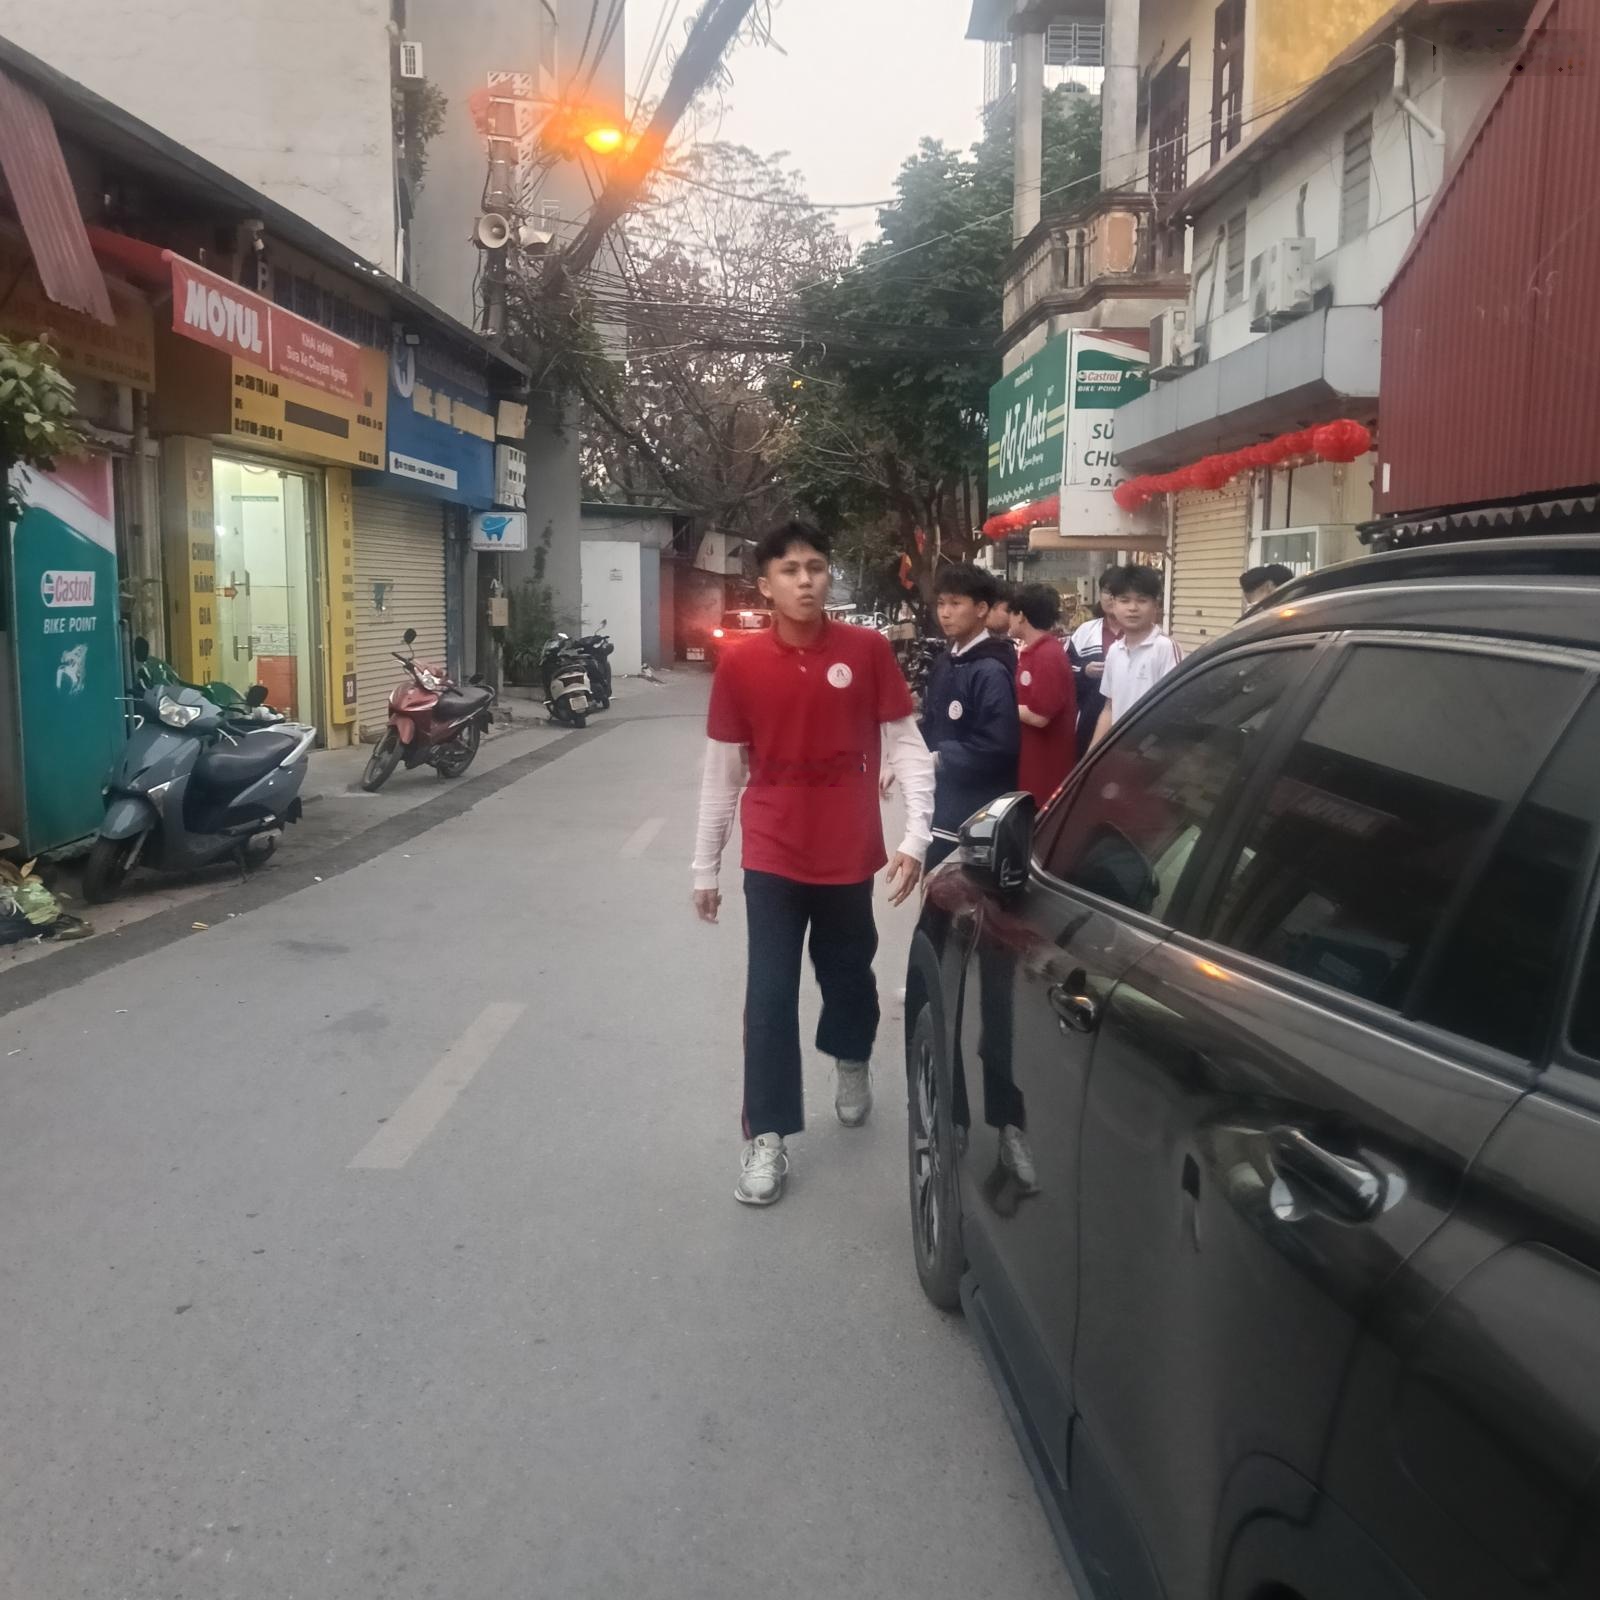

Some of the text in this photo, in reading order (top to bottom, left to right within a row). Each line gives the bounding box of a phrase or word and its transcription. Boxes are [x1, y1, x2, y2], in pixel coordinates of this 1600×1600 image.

[184, 280, 262, 353] MOTUL
[1088, 371, 1119, 381] Castrol
[55, 575, 92, 602] Castrol
[43, 616, 97, 635] BIKE POINT
